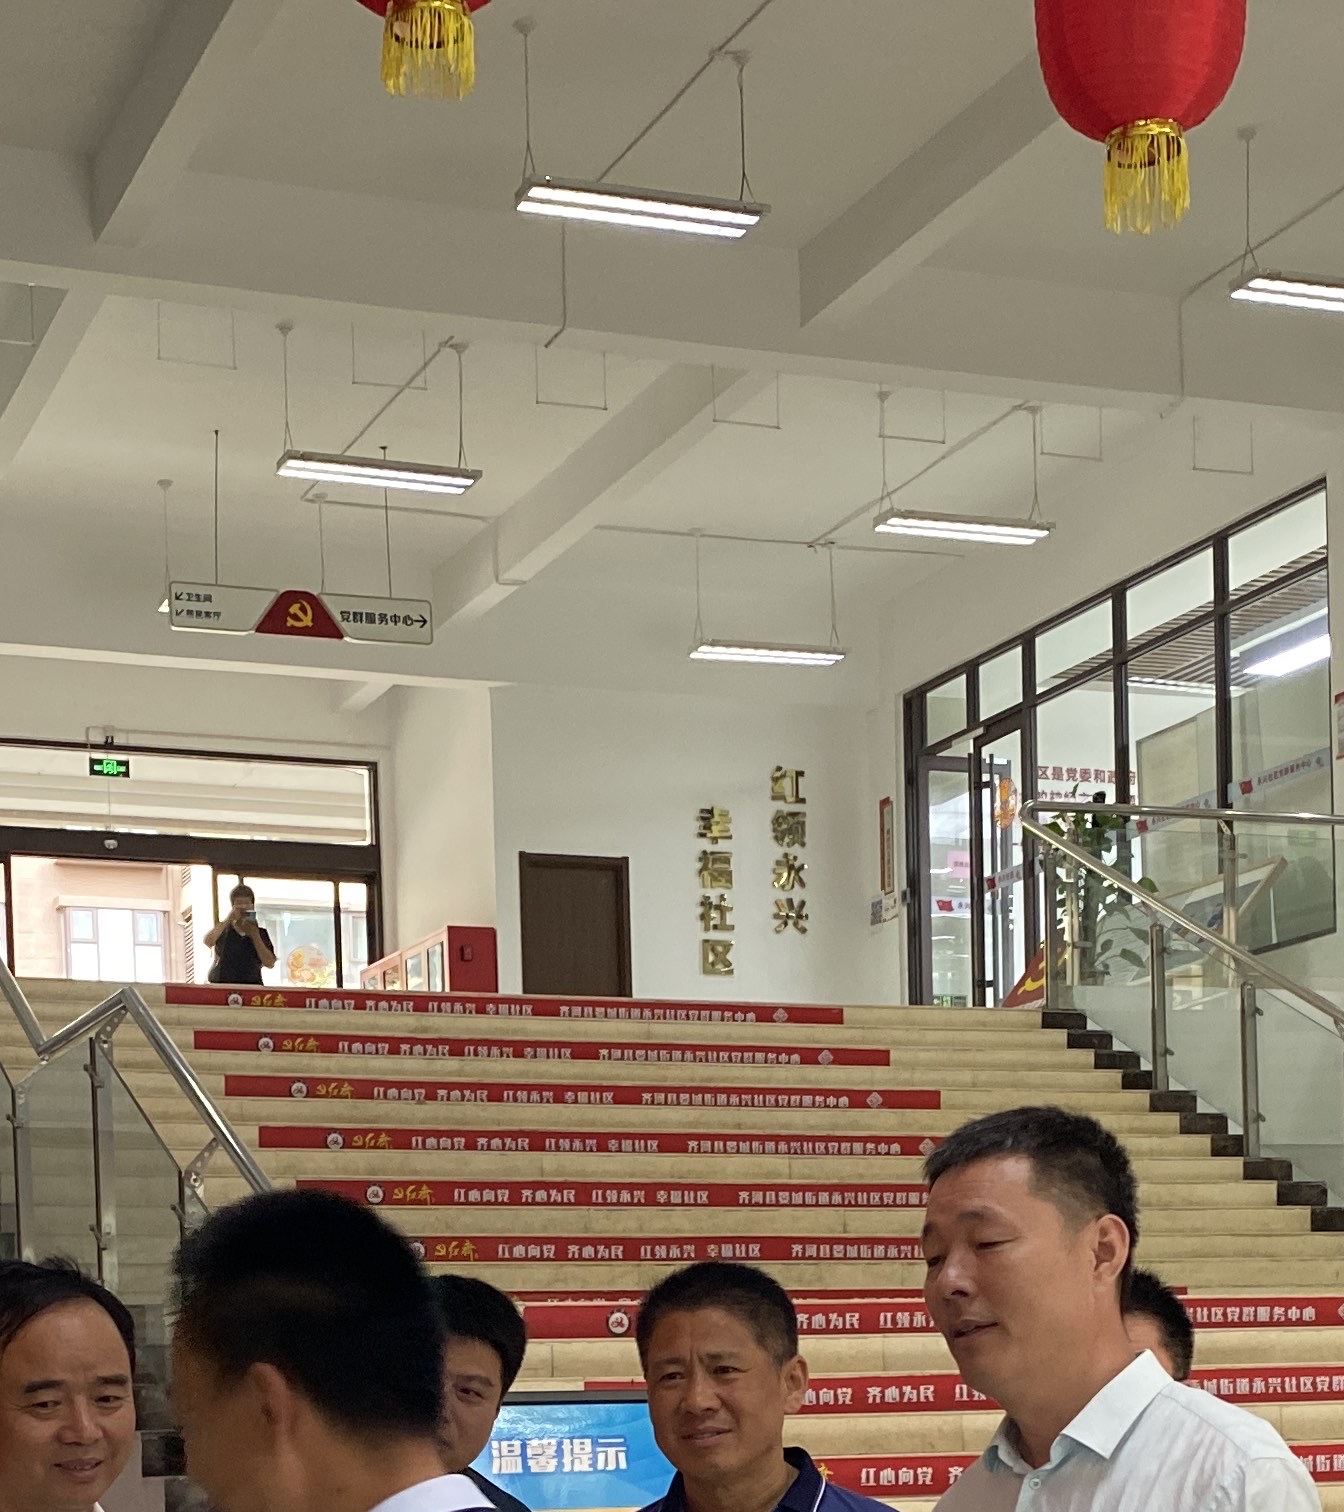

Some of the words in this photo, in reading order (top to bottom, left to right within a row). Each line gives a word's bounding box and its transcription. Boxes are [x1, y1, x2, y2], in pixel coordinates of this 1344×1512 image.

[340, 611, 414, 627] 党群服务中心
[696, 806, 735, 975] 幸福社区
[454, 1188, 509, 1203] 红心向党
[520, 1188, 575, 1203] 齐心为民
[591, 1189, 645, 1204] 红领永兴
[656, 1190, 709, 1204] 幸福社区
[497, 1243, 556, 1259] 红心向党
[567, 1244, 624, 1259] 齐心为民
[640, 1244, 696, 1259] 红领永兴
[707, 1244, 761, 1258] 幸福社区
[866, 1385, 935, 1404] 齐心为民
[490, 1438, 627, 1475] 温馨提示
[860, 1466, 934, 1486] 红心向党
